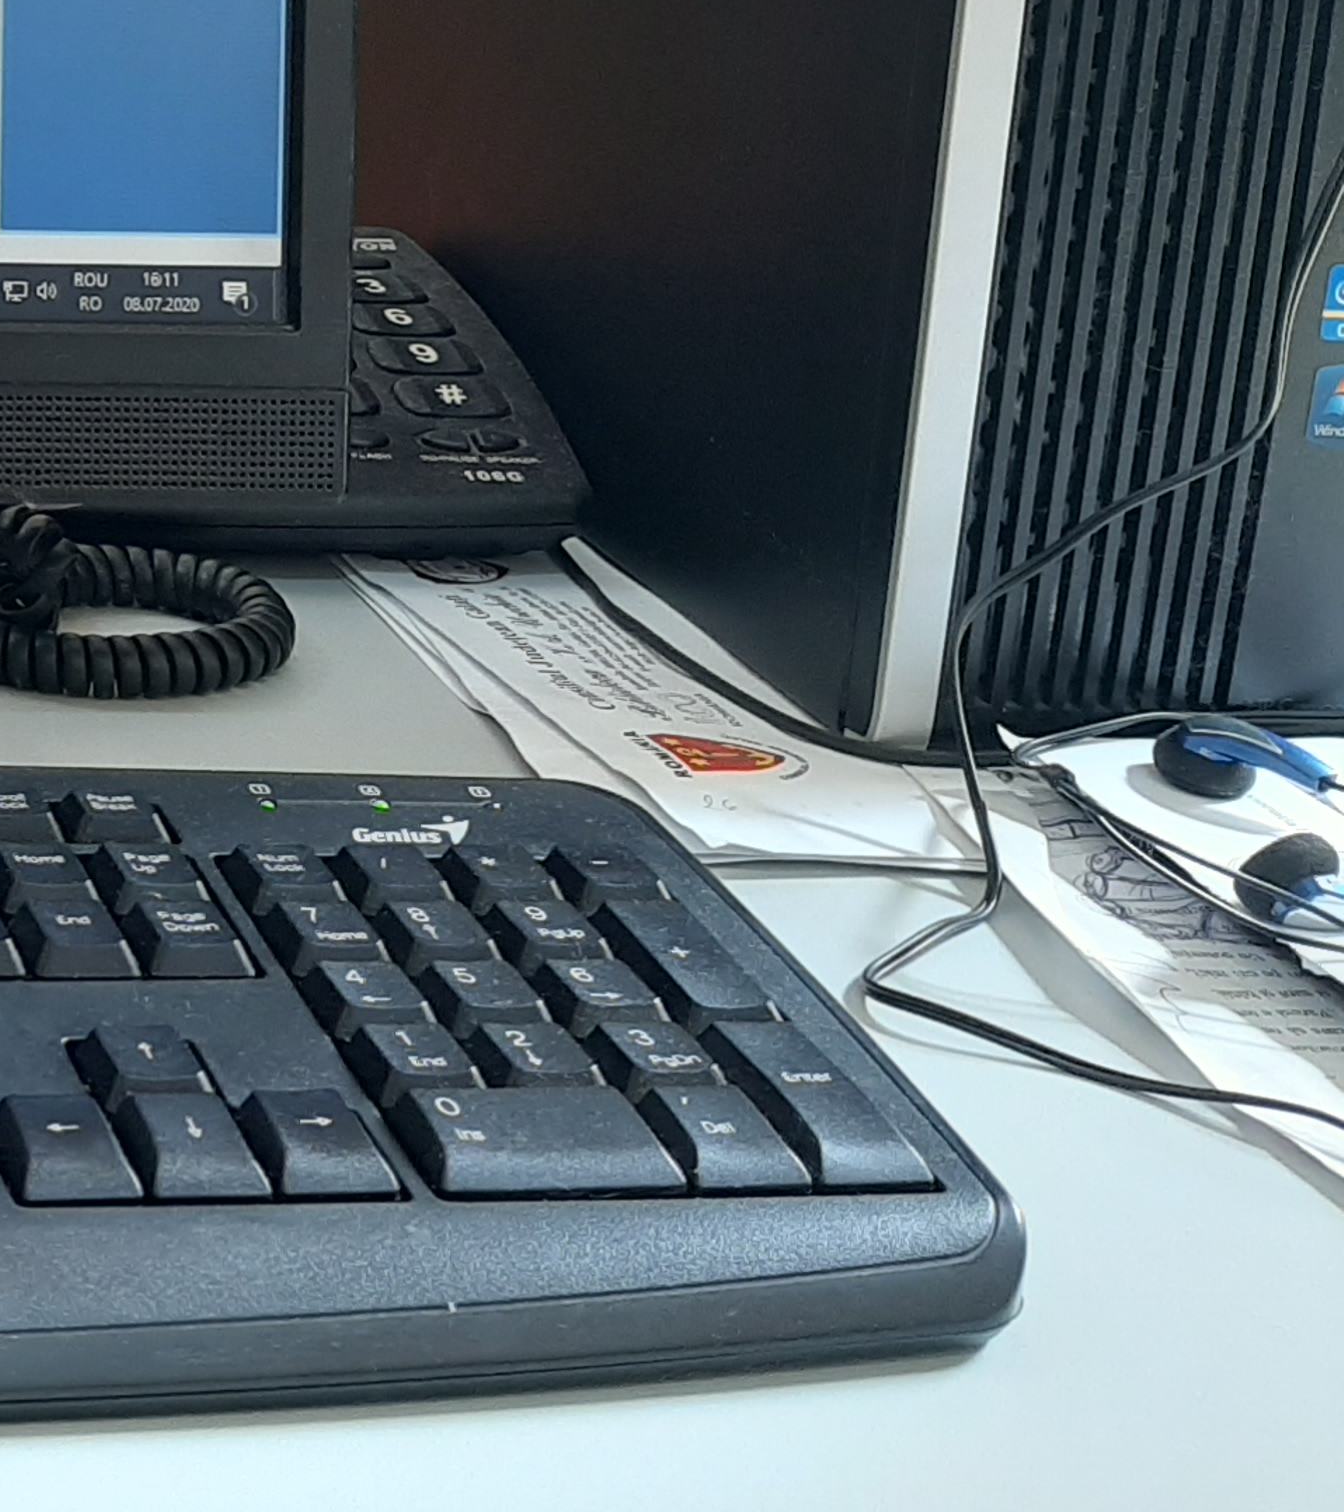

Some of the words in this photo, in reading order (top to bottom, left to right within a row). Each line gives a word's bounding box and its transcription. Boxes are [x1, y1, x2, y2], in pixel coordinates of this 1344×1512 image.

[73, 272, 109, 288] ROU
[79, 296, 103, 312] RO
[123, 296, 201, 314] 08.07.2020
[351, 827, 443, 845] Genius
